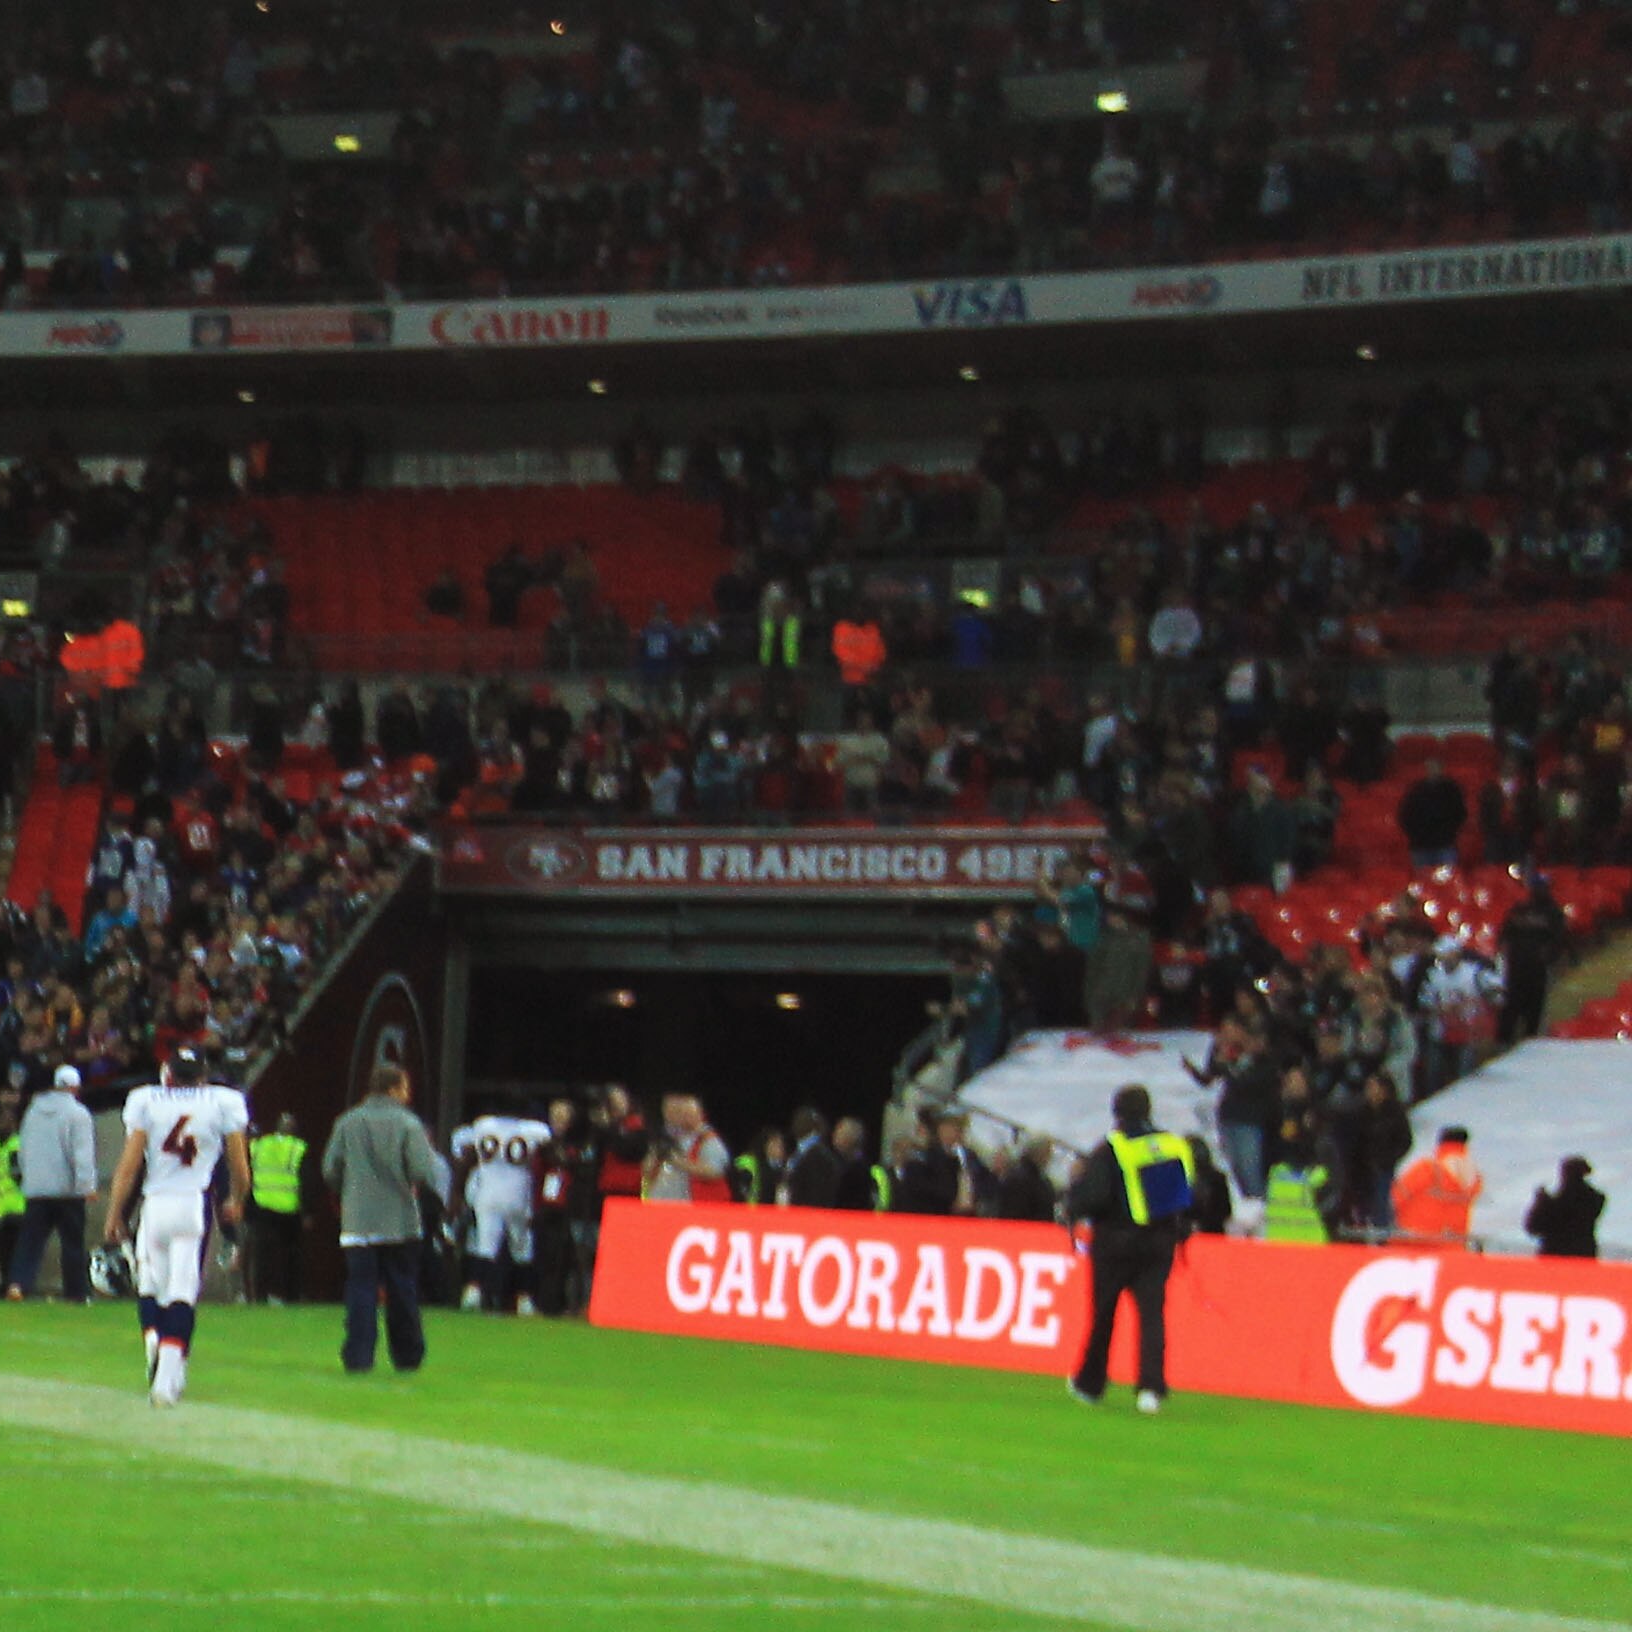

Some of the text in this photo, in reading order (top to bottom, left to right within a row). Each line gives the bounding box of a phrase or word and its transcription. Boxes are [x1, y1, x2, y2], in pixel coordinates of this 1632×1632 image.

[430, 308, 609, 344] Canon
[913, 280, 1029, 324] VISA
[597, 844, 1069, 881] SAN FRANCISCO 49E
[161, 1113, 198, 1168] 4
[666, 1226, 1067, 1347] GATORADE
[1435, 1290, 1632, 1400] SER
